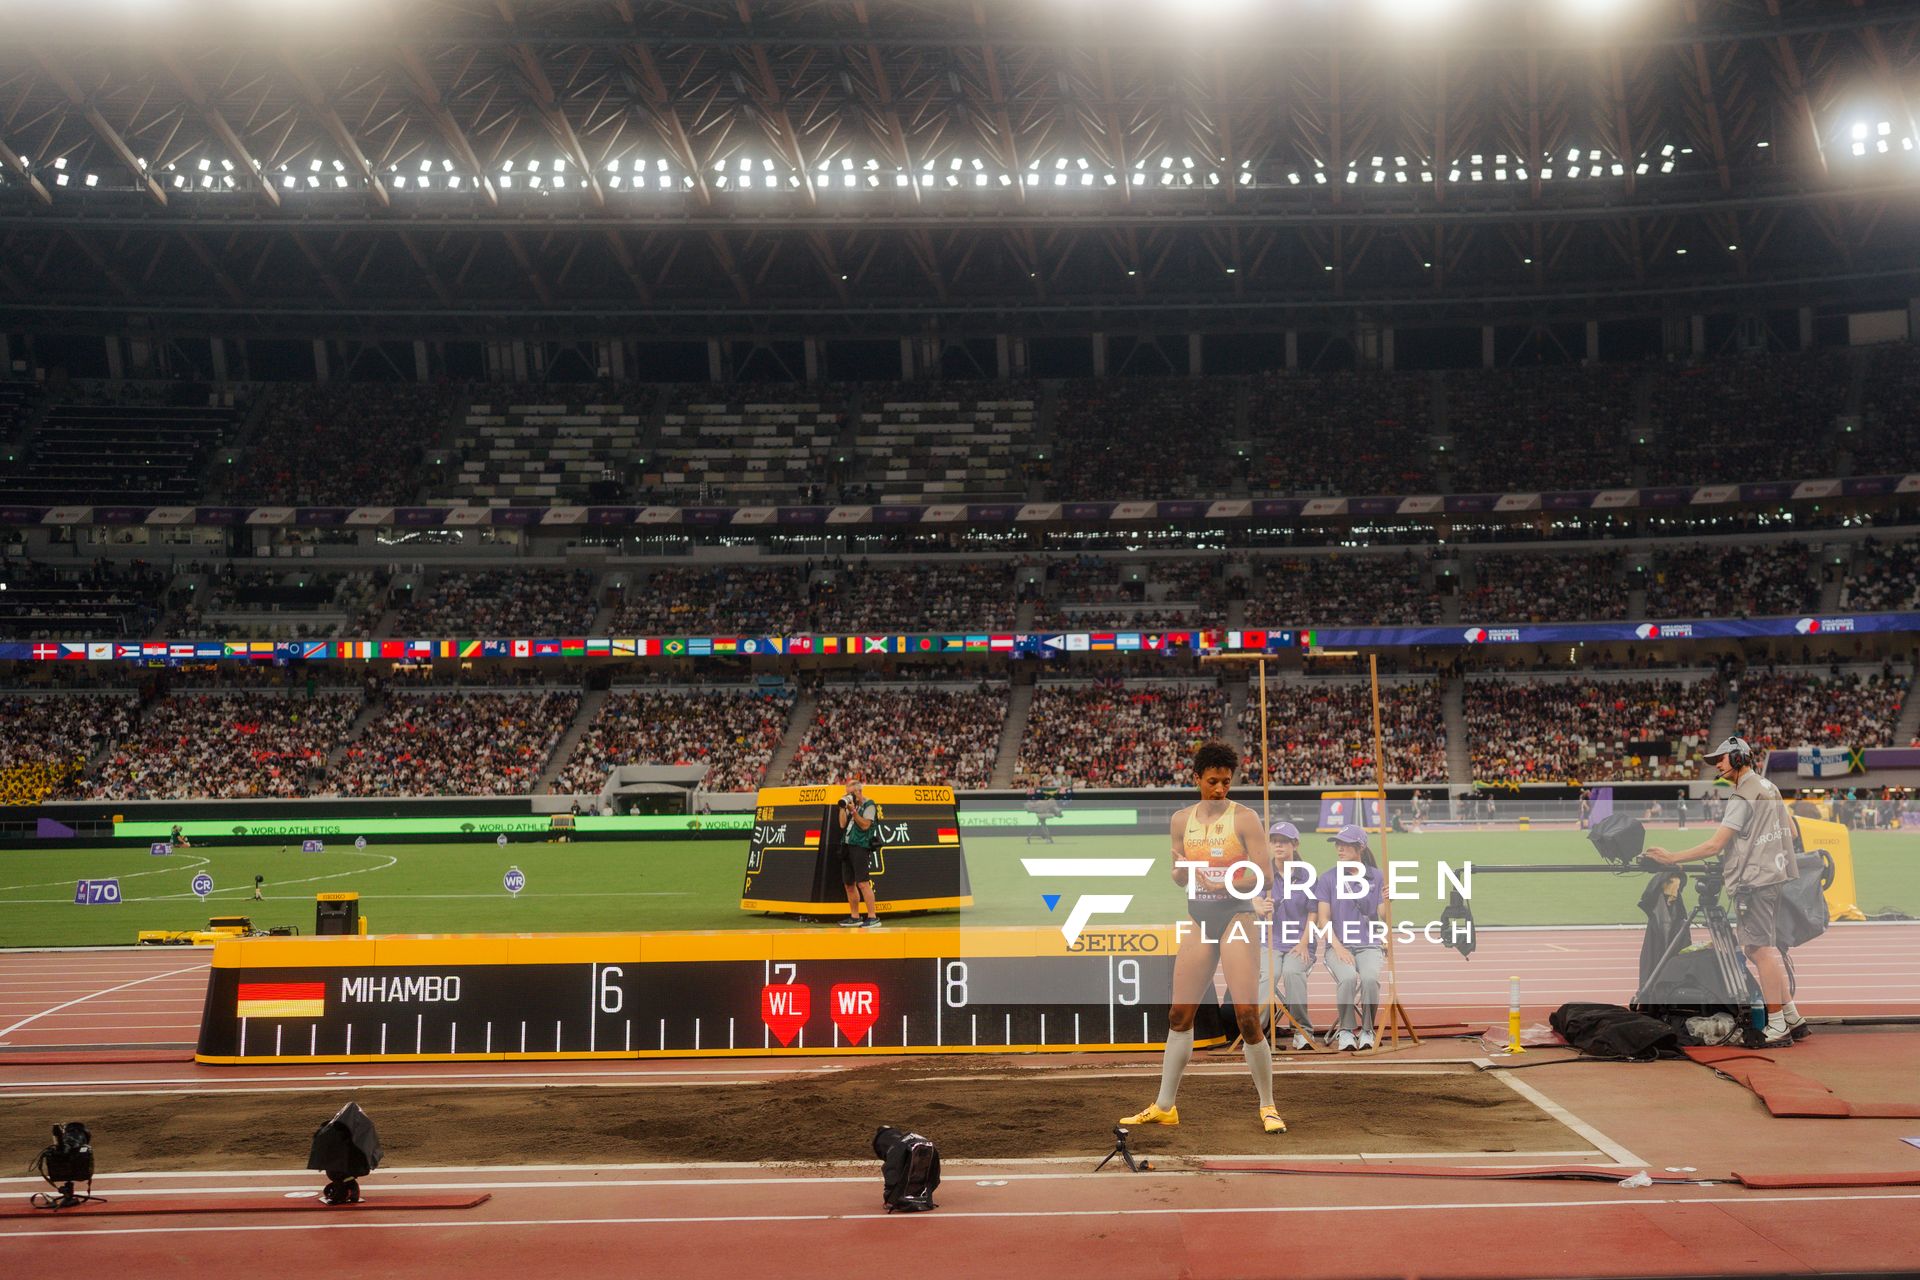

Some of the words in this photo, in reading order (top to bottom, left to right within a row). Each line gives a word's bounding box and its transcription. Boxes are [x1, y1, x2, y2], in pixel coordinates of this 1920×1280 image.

[799, 789, 827, 802] SEIKO
[914, 789, 951, 802] SEIKO
[478, 823, 514, 832] WORLD
[515, 823, 549, 832] ATHLE
[705, 821, 740, 829] WORLD
[967, 816, 1019, 826] ATHLETICS
[251, 826, 287, 835] WORLD
[288, 825, 341, 835] ATHLETICS
[874, 823, 911, 843] ハンボ
[1186, 838, 1227, 848] GERMANY
[194, 880, 211, 890] CR
[505, 876, 523, 887] WR
[90, 884, 118, 901] 70
[875, 903, 892, 912] EIKO
[1065, 933, 1159, 953] SEIKO
[774, 963, 797, 985] 7
[341, 976, 461, 1004] MIHAMBO
[600, 966, 624, 1013] 6
[945, 961, 968, 1008] 8
[1117, 959, 1141, 1006] 9
[768, 992, 803, 1016] WL
[837, 991, 873, 1015] WR
